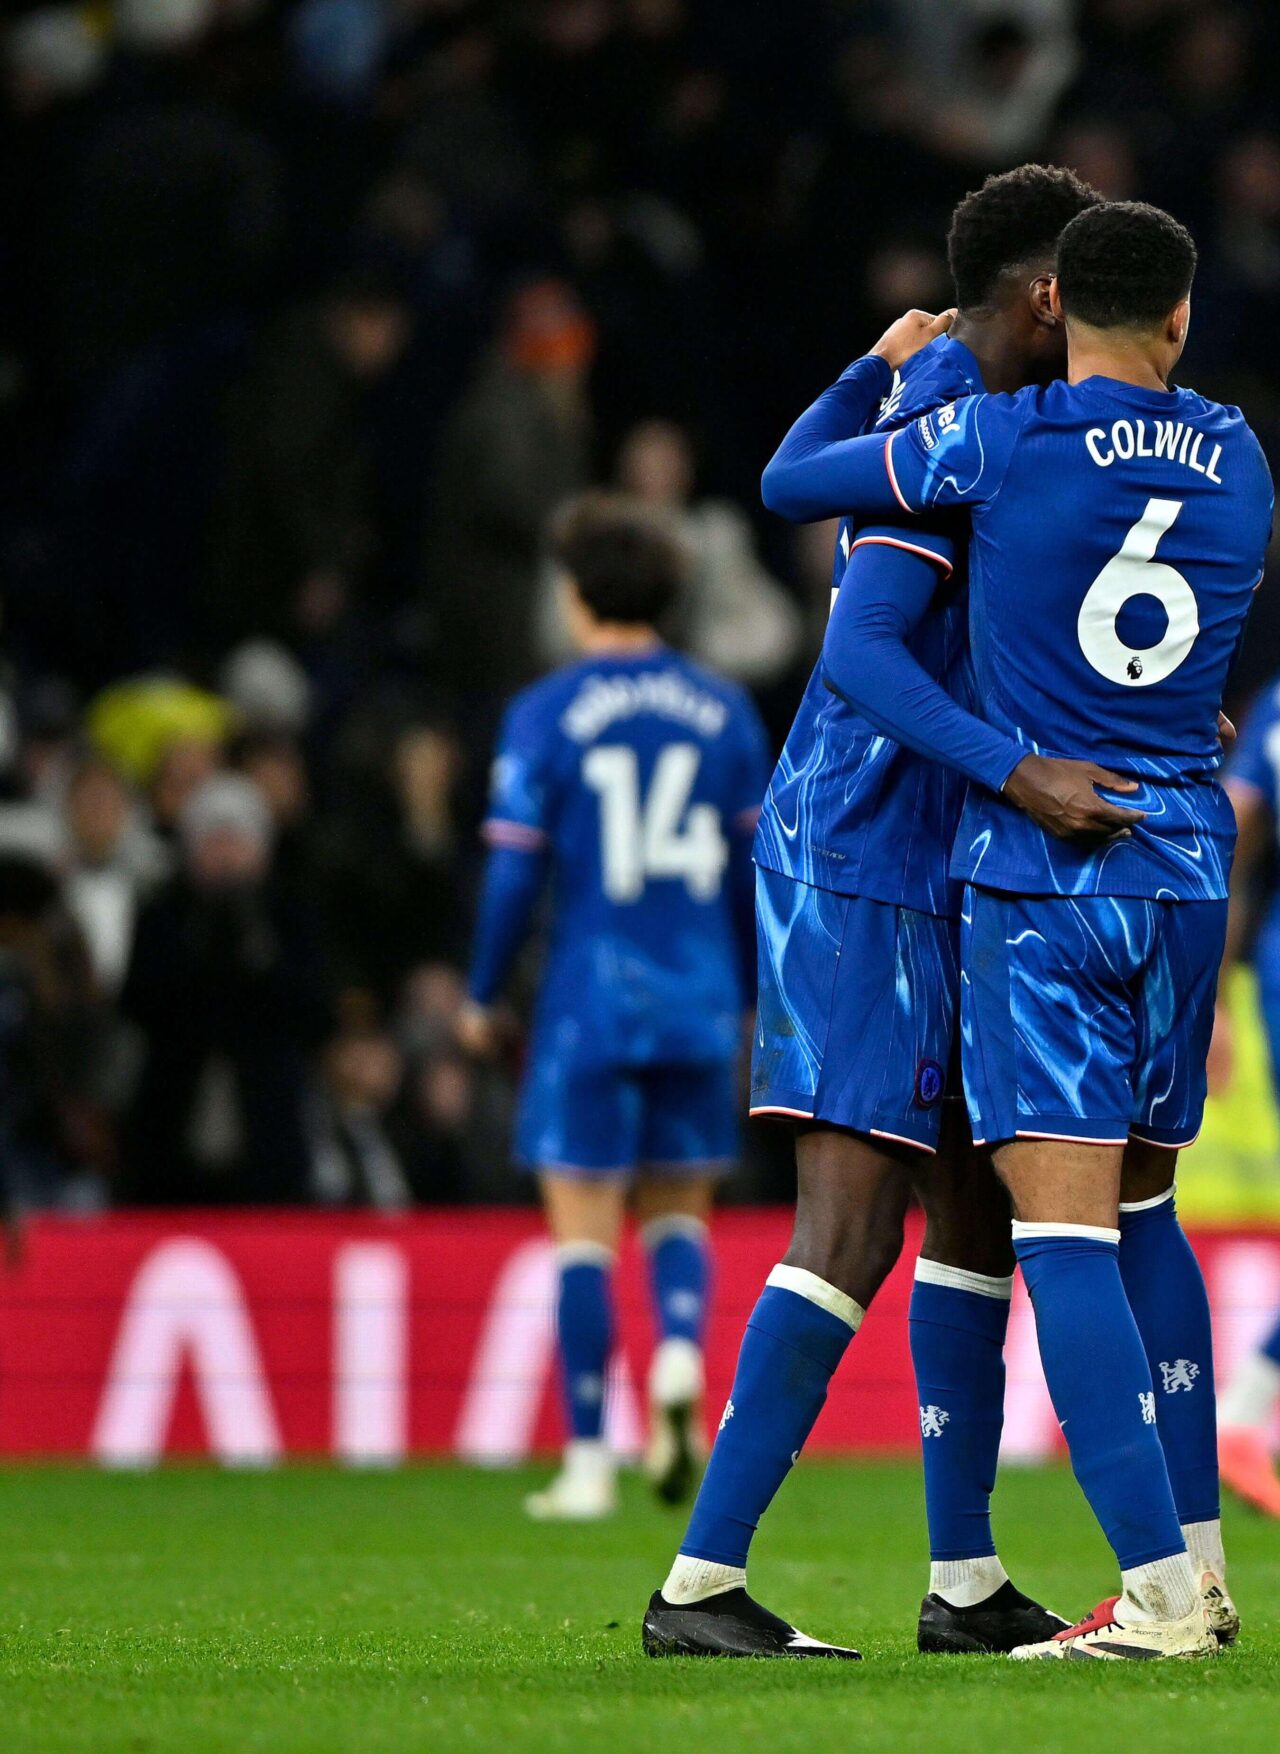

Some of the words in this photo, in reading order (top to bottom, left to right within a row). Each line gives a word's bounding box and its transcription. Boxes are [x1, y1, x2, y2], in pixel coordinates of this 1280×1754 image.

[937, 401, 961, 435] ver
[1085, 419, 1223, 484] COLWILL
[1077, 497, 1200, 686] 6
[580, 744, 729, 904] 14
